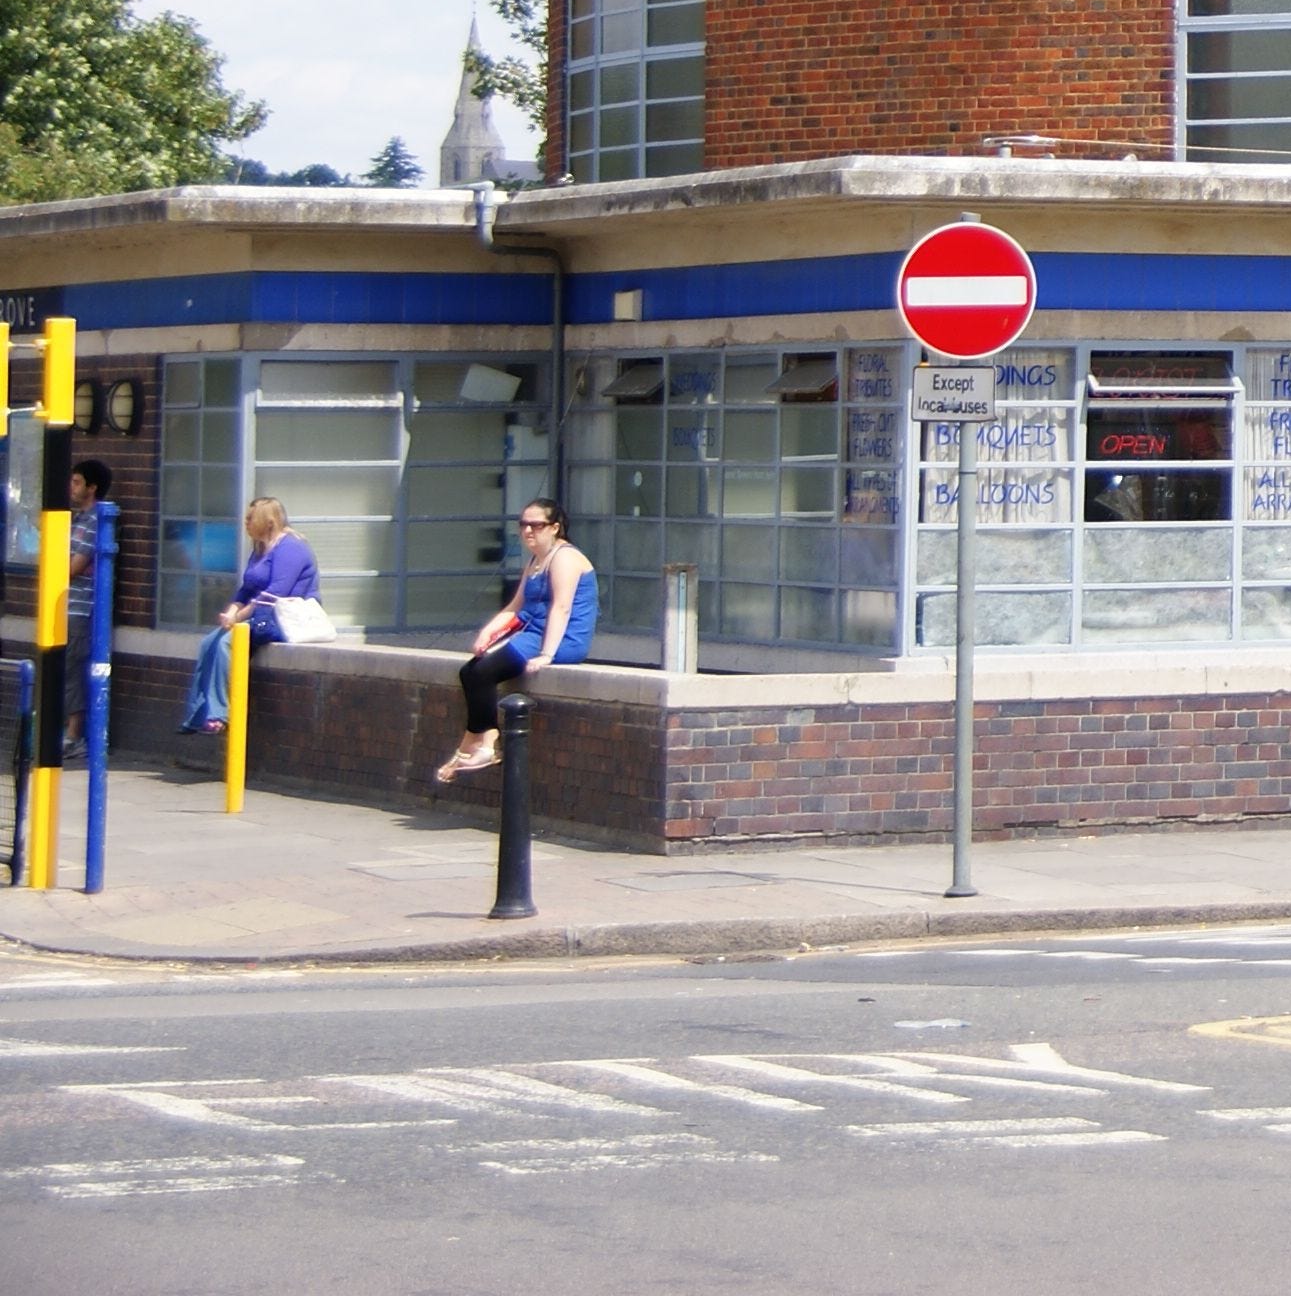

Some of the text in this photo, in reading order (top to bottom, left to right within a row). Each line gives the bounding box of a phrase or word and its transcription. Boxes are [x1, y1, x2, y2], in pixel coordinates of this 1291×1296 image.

[0, 297, 35, 327] ROVE
[933, 374, 974, 394] Except
[996, 365, 1057, 386] DINGS
[1100, 435, 1168, 454] OPEN
[1259, 470, 1291, 489] ALL
[936, 483, 1055, 504] BLOONS
[52, 1042, 1214, 1130] ENTRY
